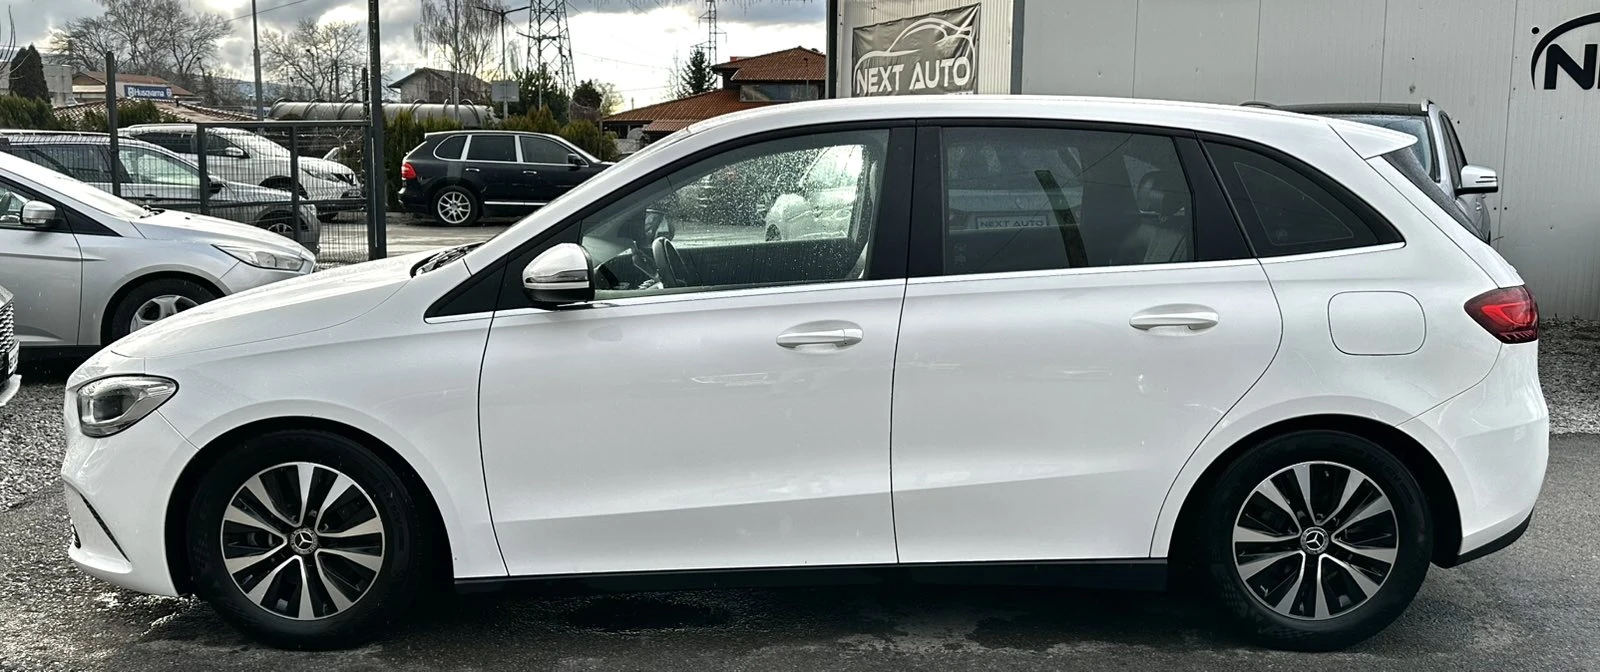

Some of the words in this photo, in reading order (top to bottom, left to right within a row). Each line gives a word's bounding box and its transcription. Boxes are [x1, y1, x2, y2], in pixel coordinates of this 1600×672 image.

[856, 64, 905, 95] NEXT
[909, 56, 971, 90] AUTO
[1543, 43, 1600, 91] N
[980, 220, 1009, 228] NEXT
[1014, 220, 1044, 228] AUTO
